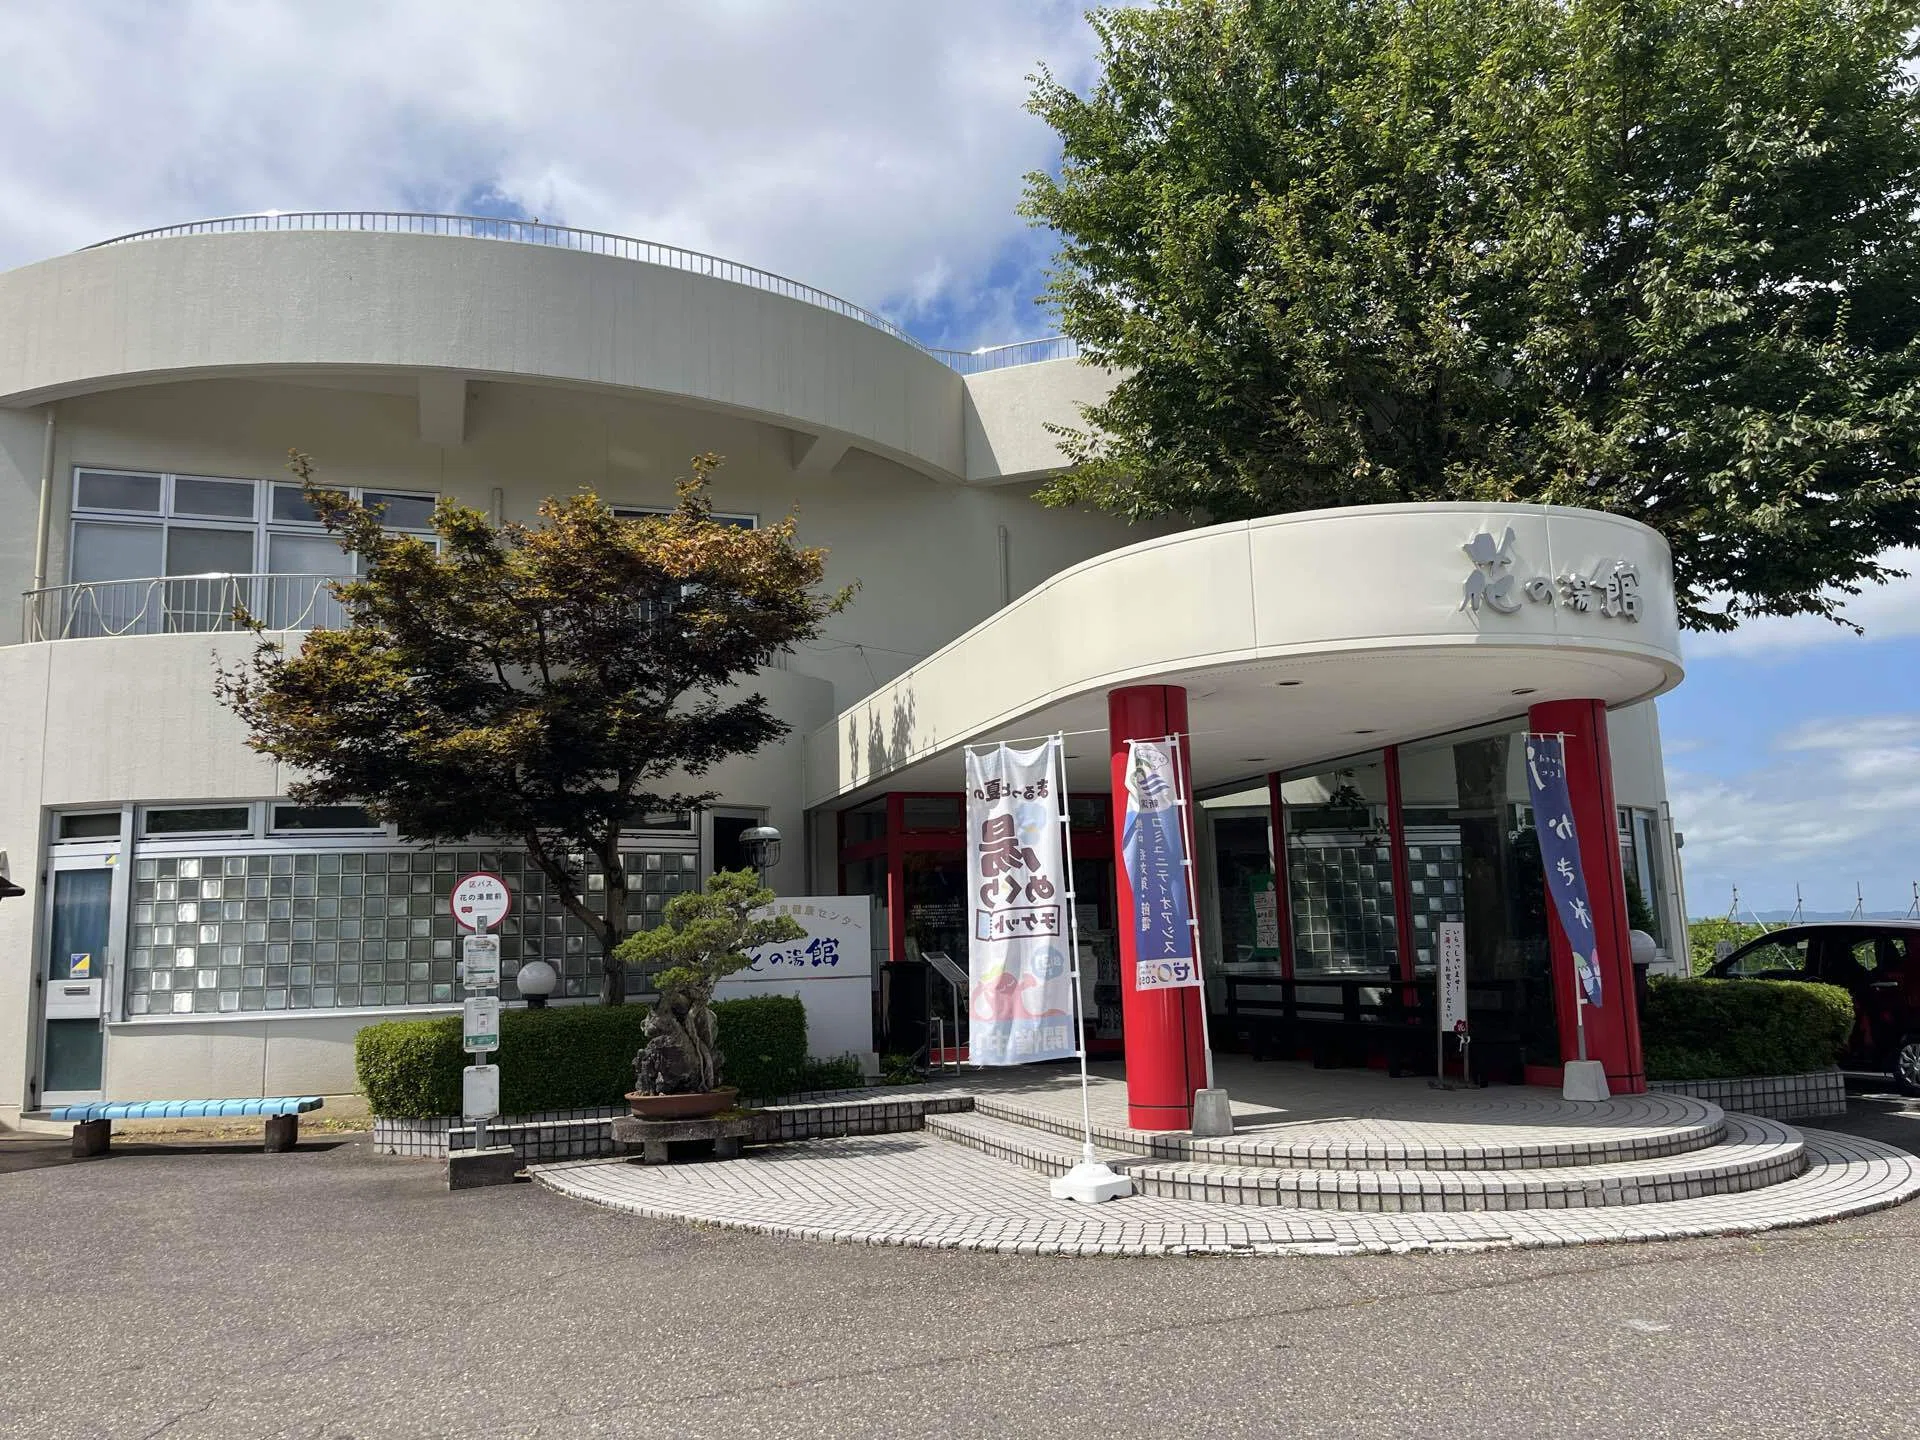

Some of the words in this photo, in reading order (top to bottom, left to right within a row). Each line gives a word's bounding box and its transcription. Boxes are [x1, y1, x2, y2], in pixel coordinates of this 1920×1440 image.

[1459, 526, 1643, 623] 花の湯館
[469, 880, 492, 888] 区バス
[460, 893, 502, 902] 花の湯館前
